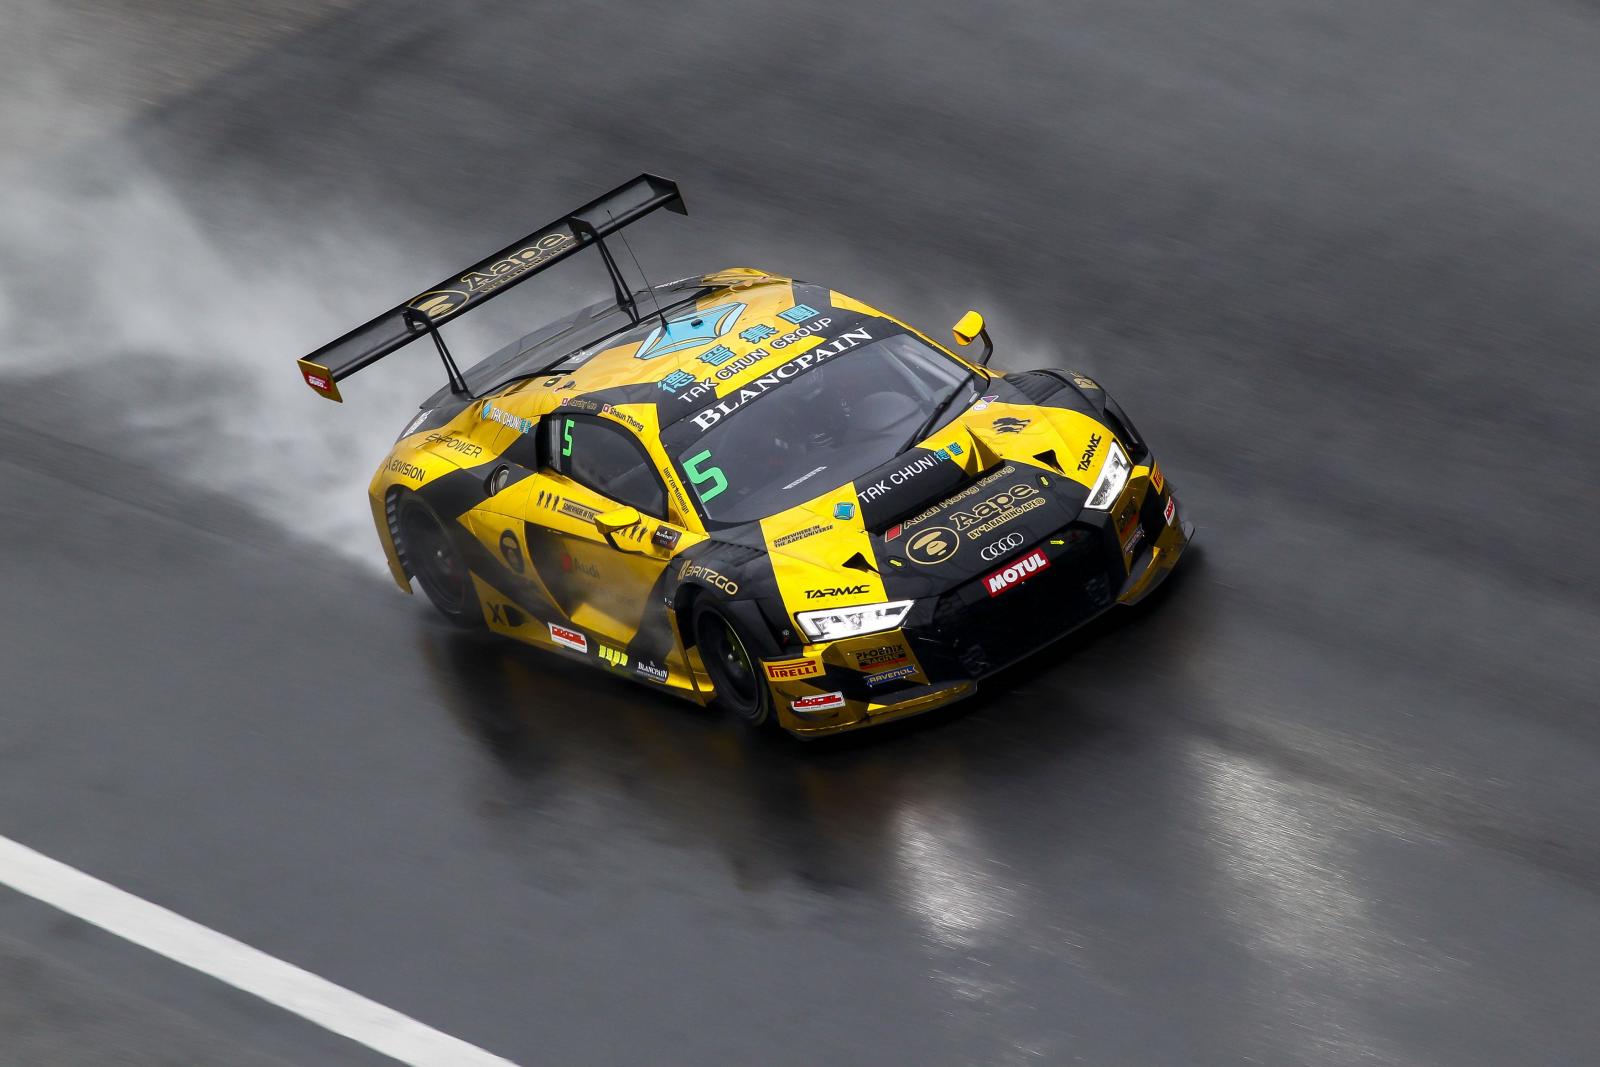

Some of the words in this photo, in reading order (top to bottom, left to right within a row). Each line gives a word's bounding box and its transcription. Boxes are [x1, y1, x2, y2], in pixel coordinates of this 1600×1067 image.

[461, 233, 571, 292] Aape
[678, 377, 720, 403] TAK
[715, 347, 770, 380] CHUN
[770, 317, 833, 349] GROUP
[690, 326, 873, 433] BLANCPAIN
[491, 406, 504, 424] TAK
[609, 407, 626, 421] Shaun
[626, 415, 645, 432] Thong
[562, 418, 575, 457] 5
[1077, 432, 1102, 471] TARMAC
[682, 449, 728, 503] 5
[857, 479, 892, 503] TAK
[889, 457, 934, 485] CHUN
[904, 505, 941, 530] Audi
[939, 486, 980, 510] Hong
[977, 465, 1016, 488] Kong
[949, 483, 1040, 532] Aape
[773, 526, 813, 544] SOMEWHERE
[990, 506, 1024, 529] BATHING
[685, 565, 739, 595] BRITZGO
[804, 584, 870, 599] TARMAC
[988, 553, 1047, 593] MOTUL
[638, 661, 668, 678] BLANCPAIN
[767, 660, 818, 678] PIRELLI
